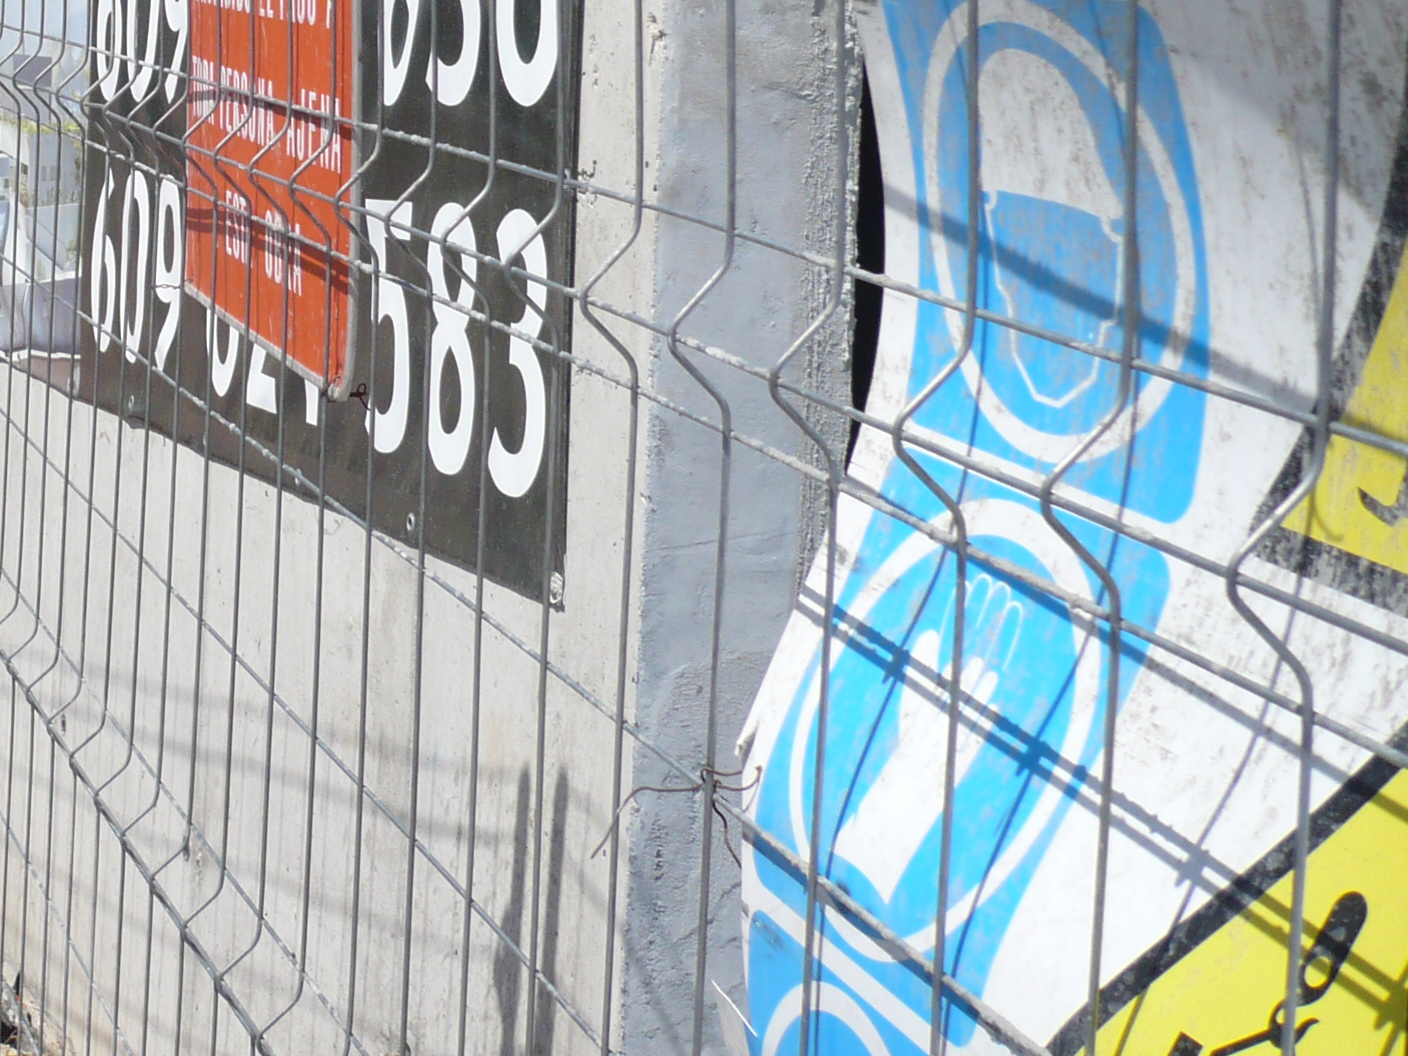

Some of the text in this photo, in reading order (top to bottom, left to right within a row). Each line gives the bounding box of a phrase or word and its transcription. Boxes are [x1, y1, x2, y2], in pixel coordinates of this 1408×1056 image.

[225, 189, 253, 269] EST
[91, 167, 183, 372] 609
[364, 198, 550, 498] 583
